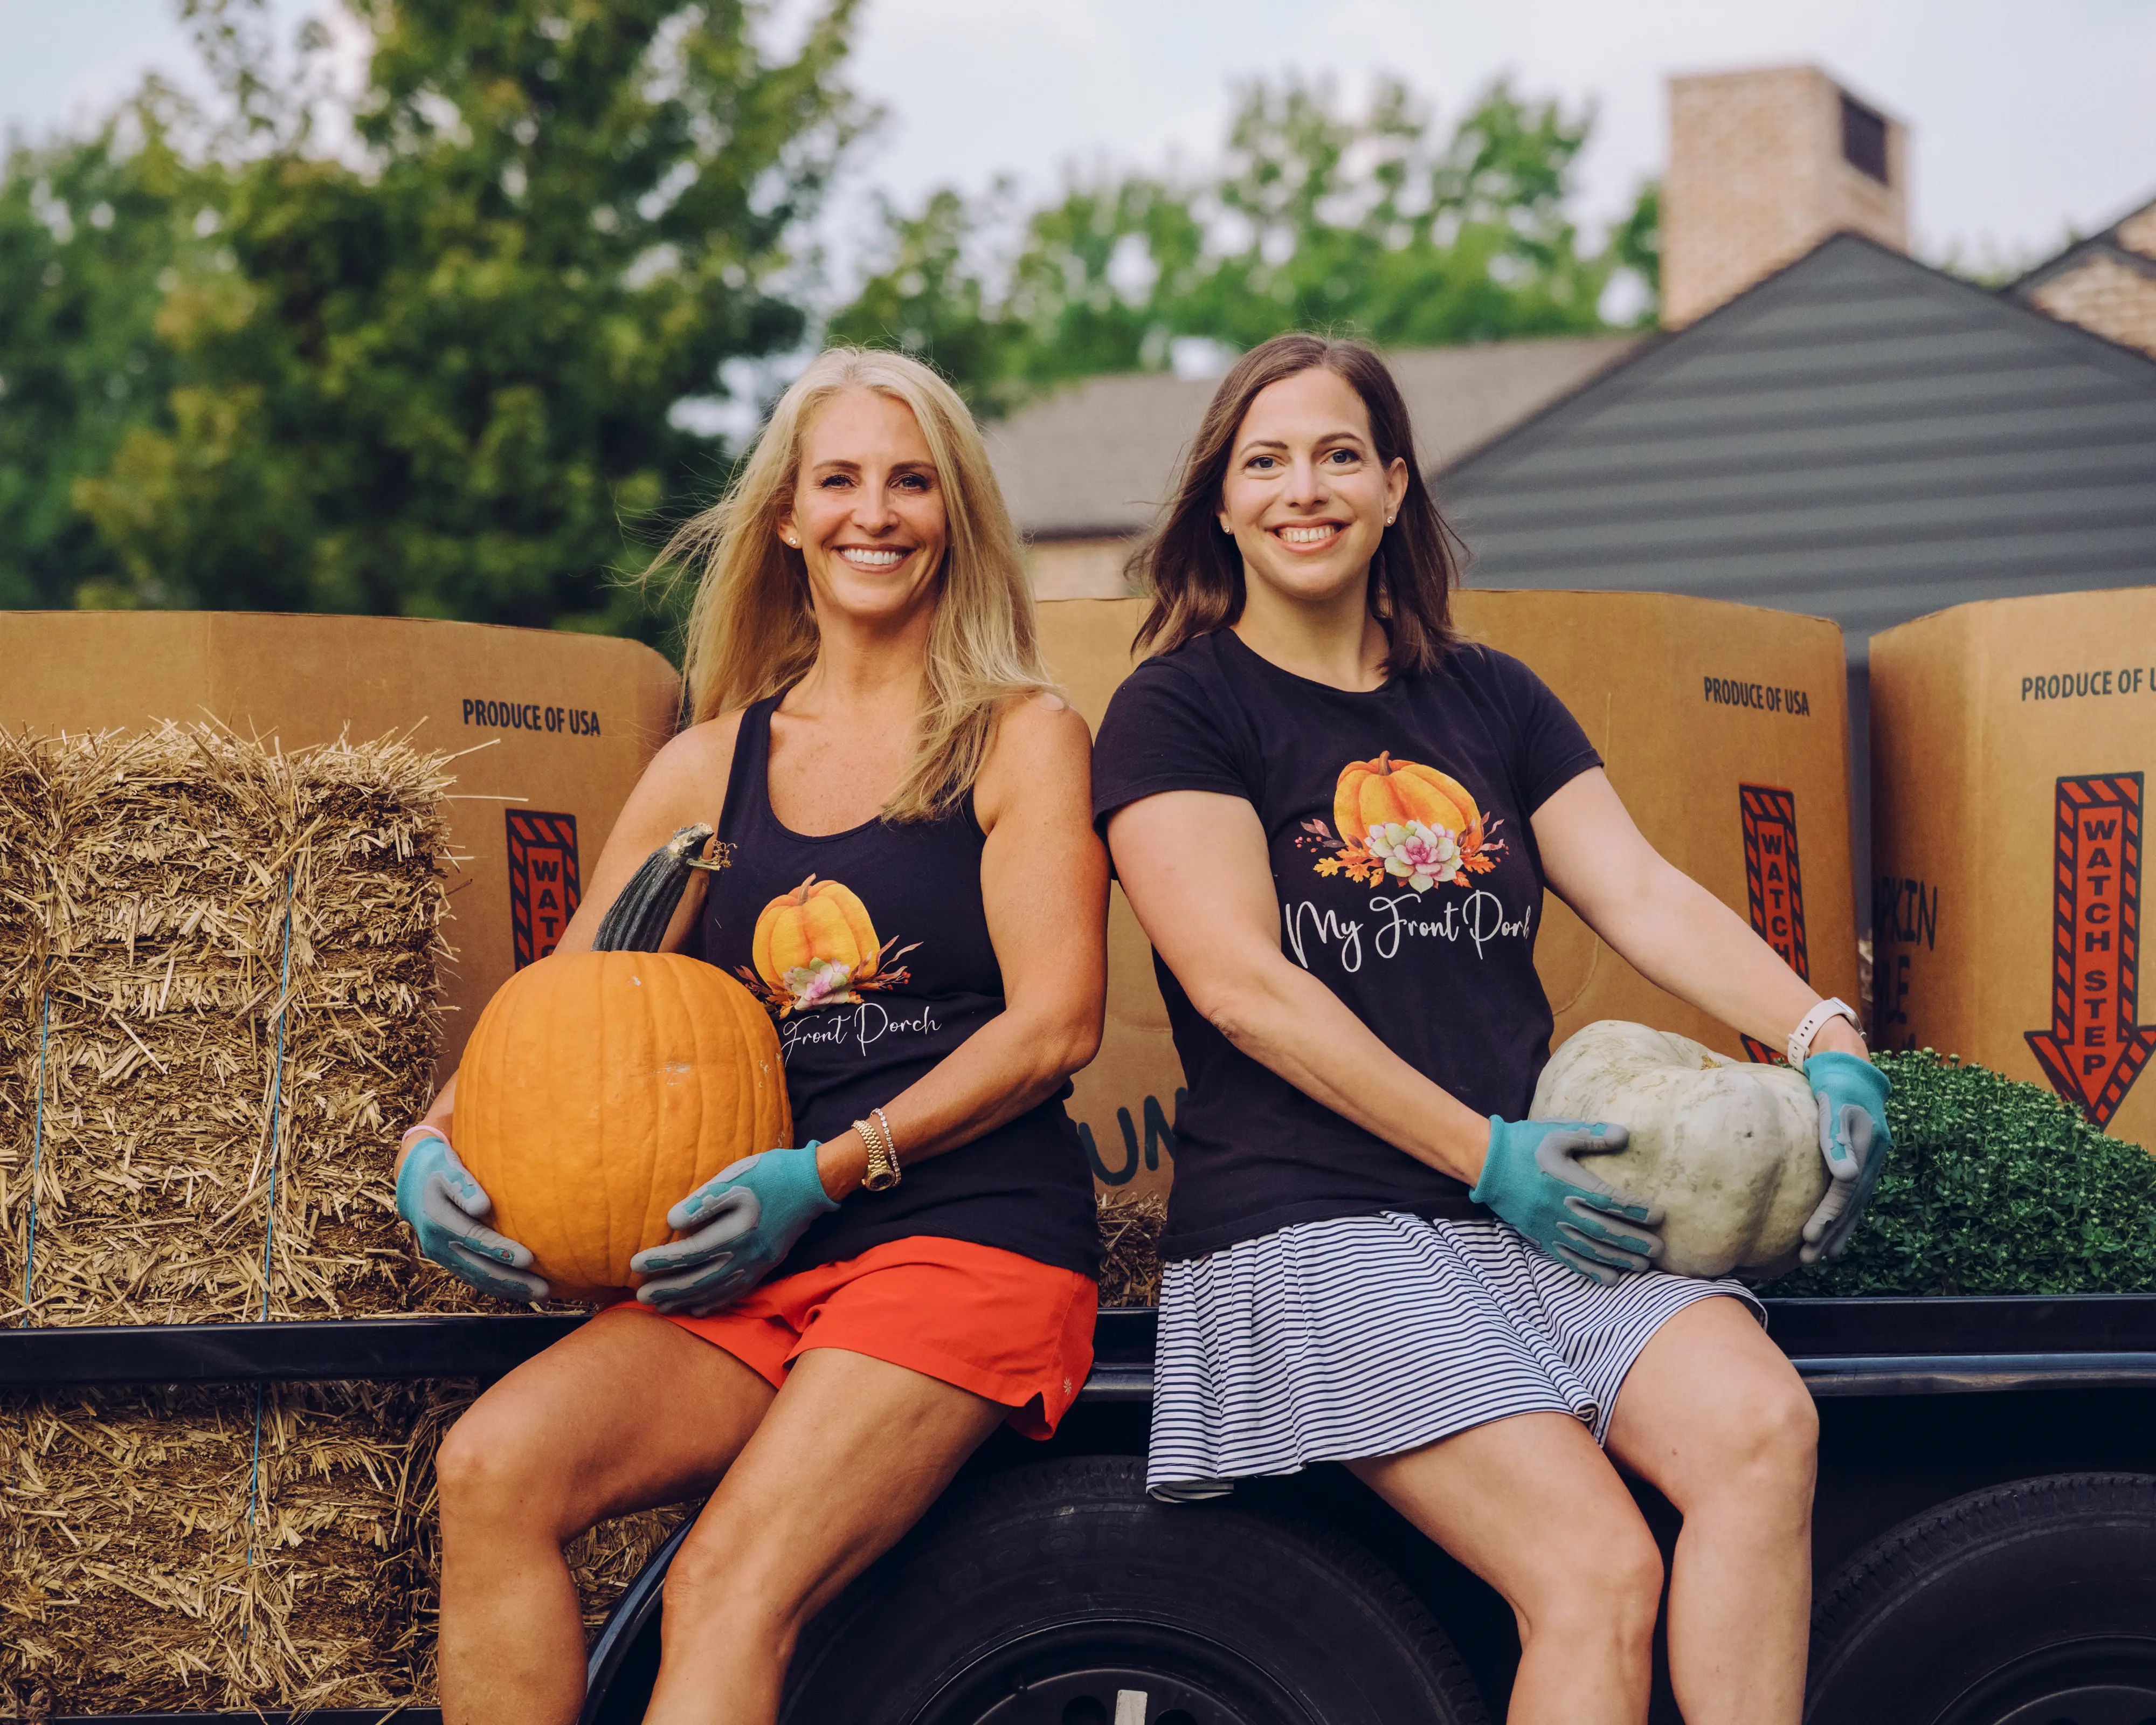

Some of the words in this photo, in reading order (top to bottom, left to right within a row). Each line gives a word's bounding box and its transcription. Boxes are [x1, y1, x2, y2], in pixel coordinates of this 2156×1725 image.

[1704, 677, 1764, 710] PRODUCE
[1766, 686, 1781, 712] OF
[1785, 688, 1810, 717] USA
[2022, 671, 2112, 701] PRODUCE
[2118, 669, 2143, 694] OF
[462, 699, 542, 731] PRODUCE
[545, 707, 565, 733] OF
[569, 709, 601, 737] USA
[2083, 819, 2117, 952] WATCH
[1285, 901, 1364, 972] My
[1370, 893, 1459, 958] Front
[1463, 888, 1531, 960] Porh
[782, 1015, 851, 1067] Front
[854, 1003, 942, 1057] Porch
[2083, 970, 2107, 1075] STEP
